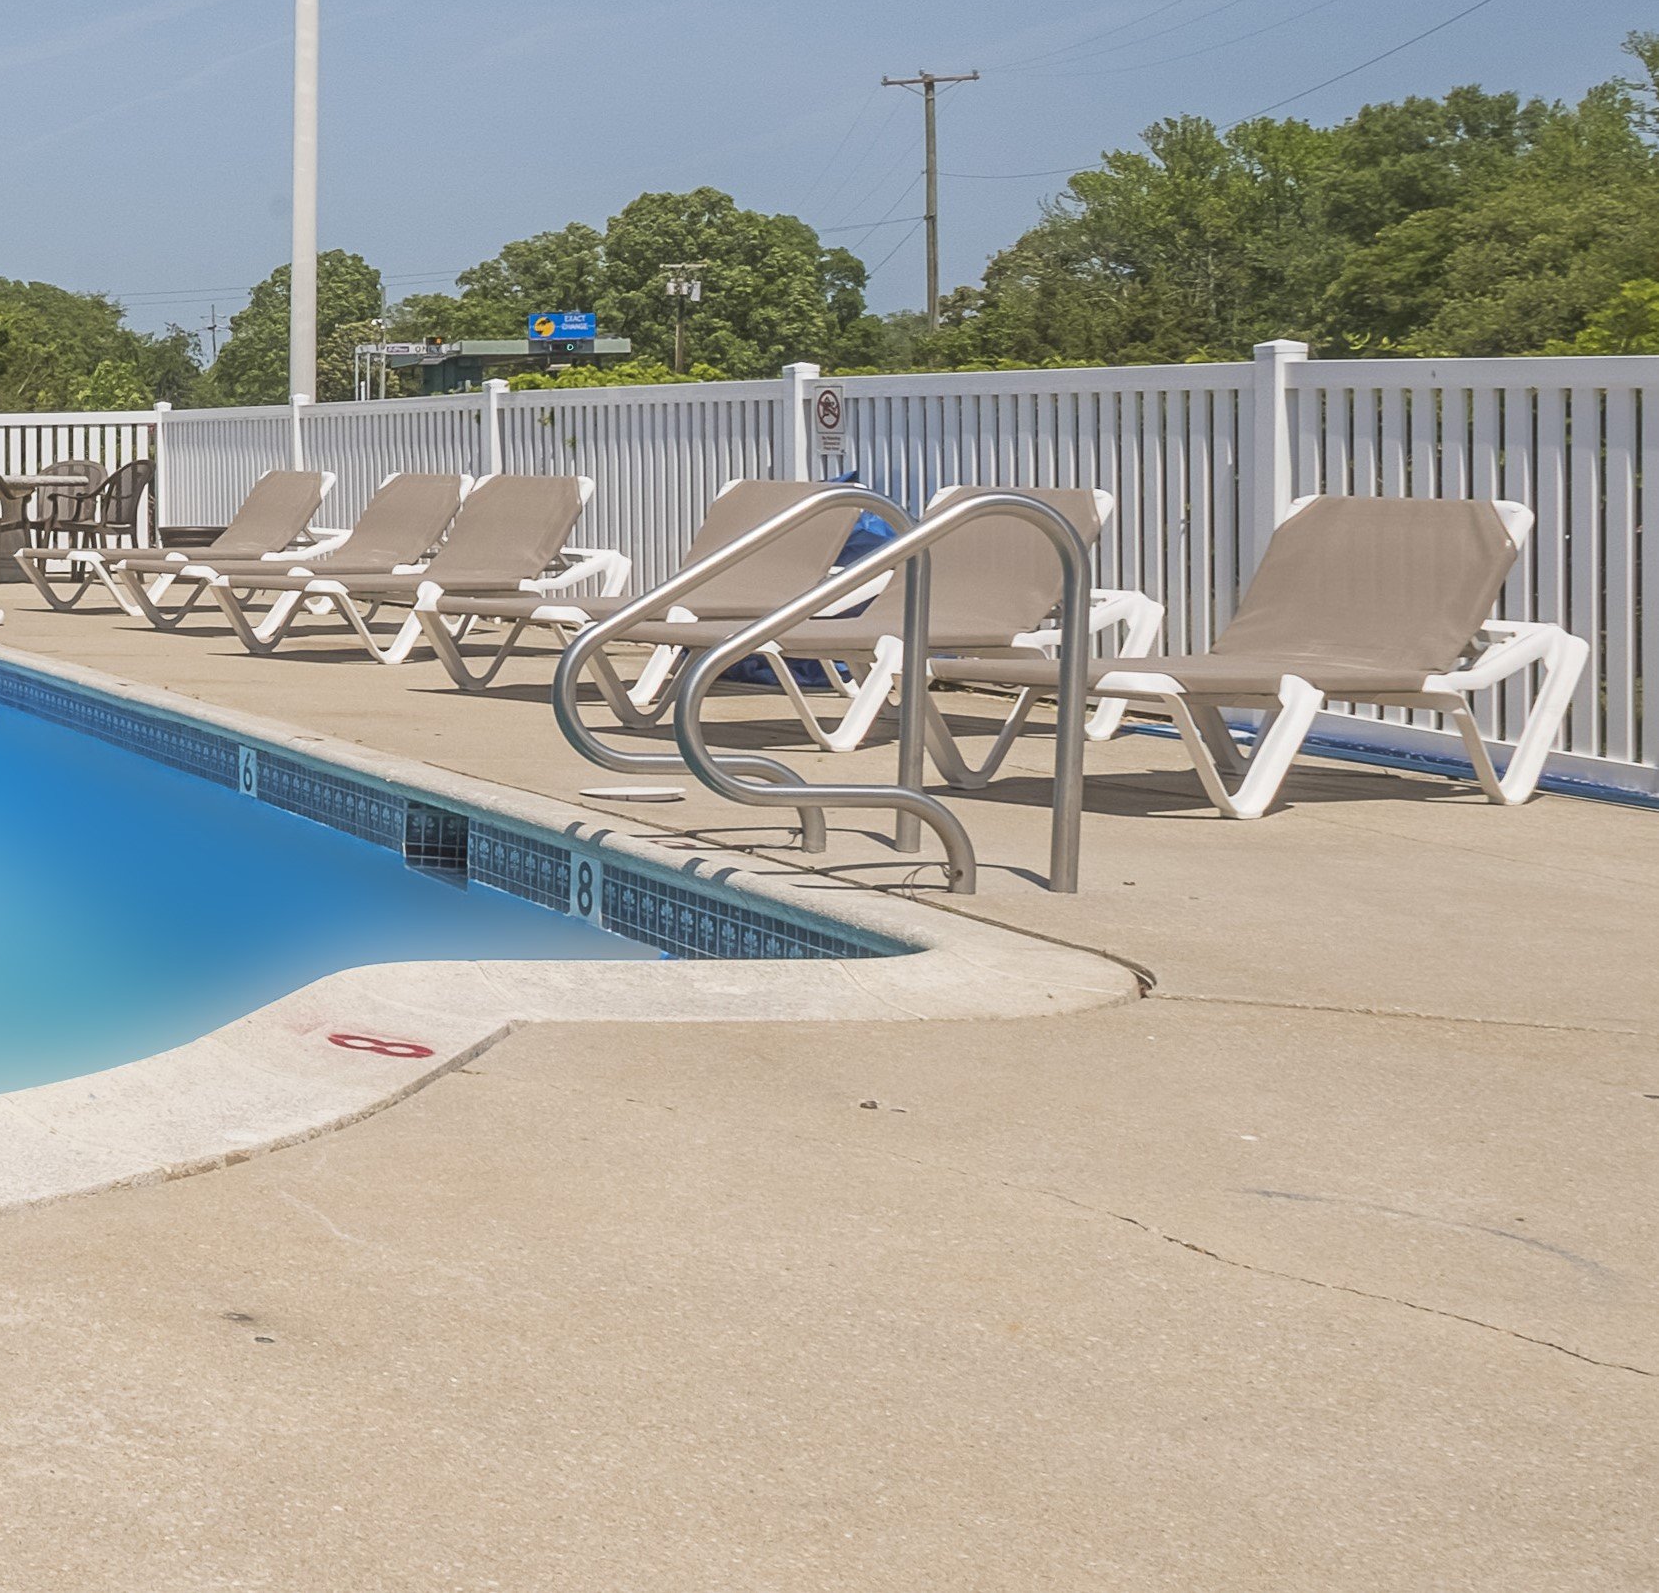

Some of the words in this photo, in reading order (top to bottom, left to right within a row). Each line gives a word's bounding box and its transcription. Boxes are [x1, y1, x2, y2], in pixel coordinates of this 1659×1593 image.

[243, 751, 253, 792] 6
[577, 860, 593, 917] 8
[327, 1033, 435, 1058] 8
